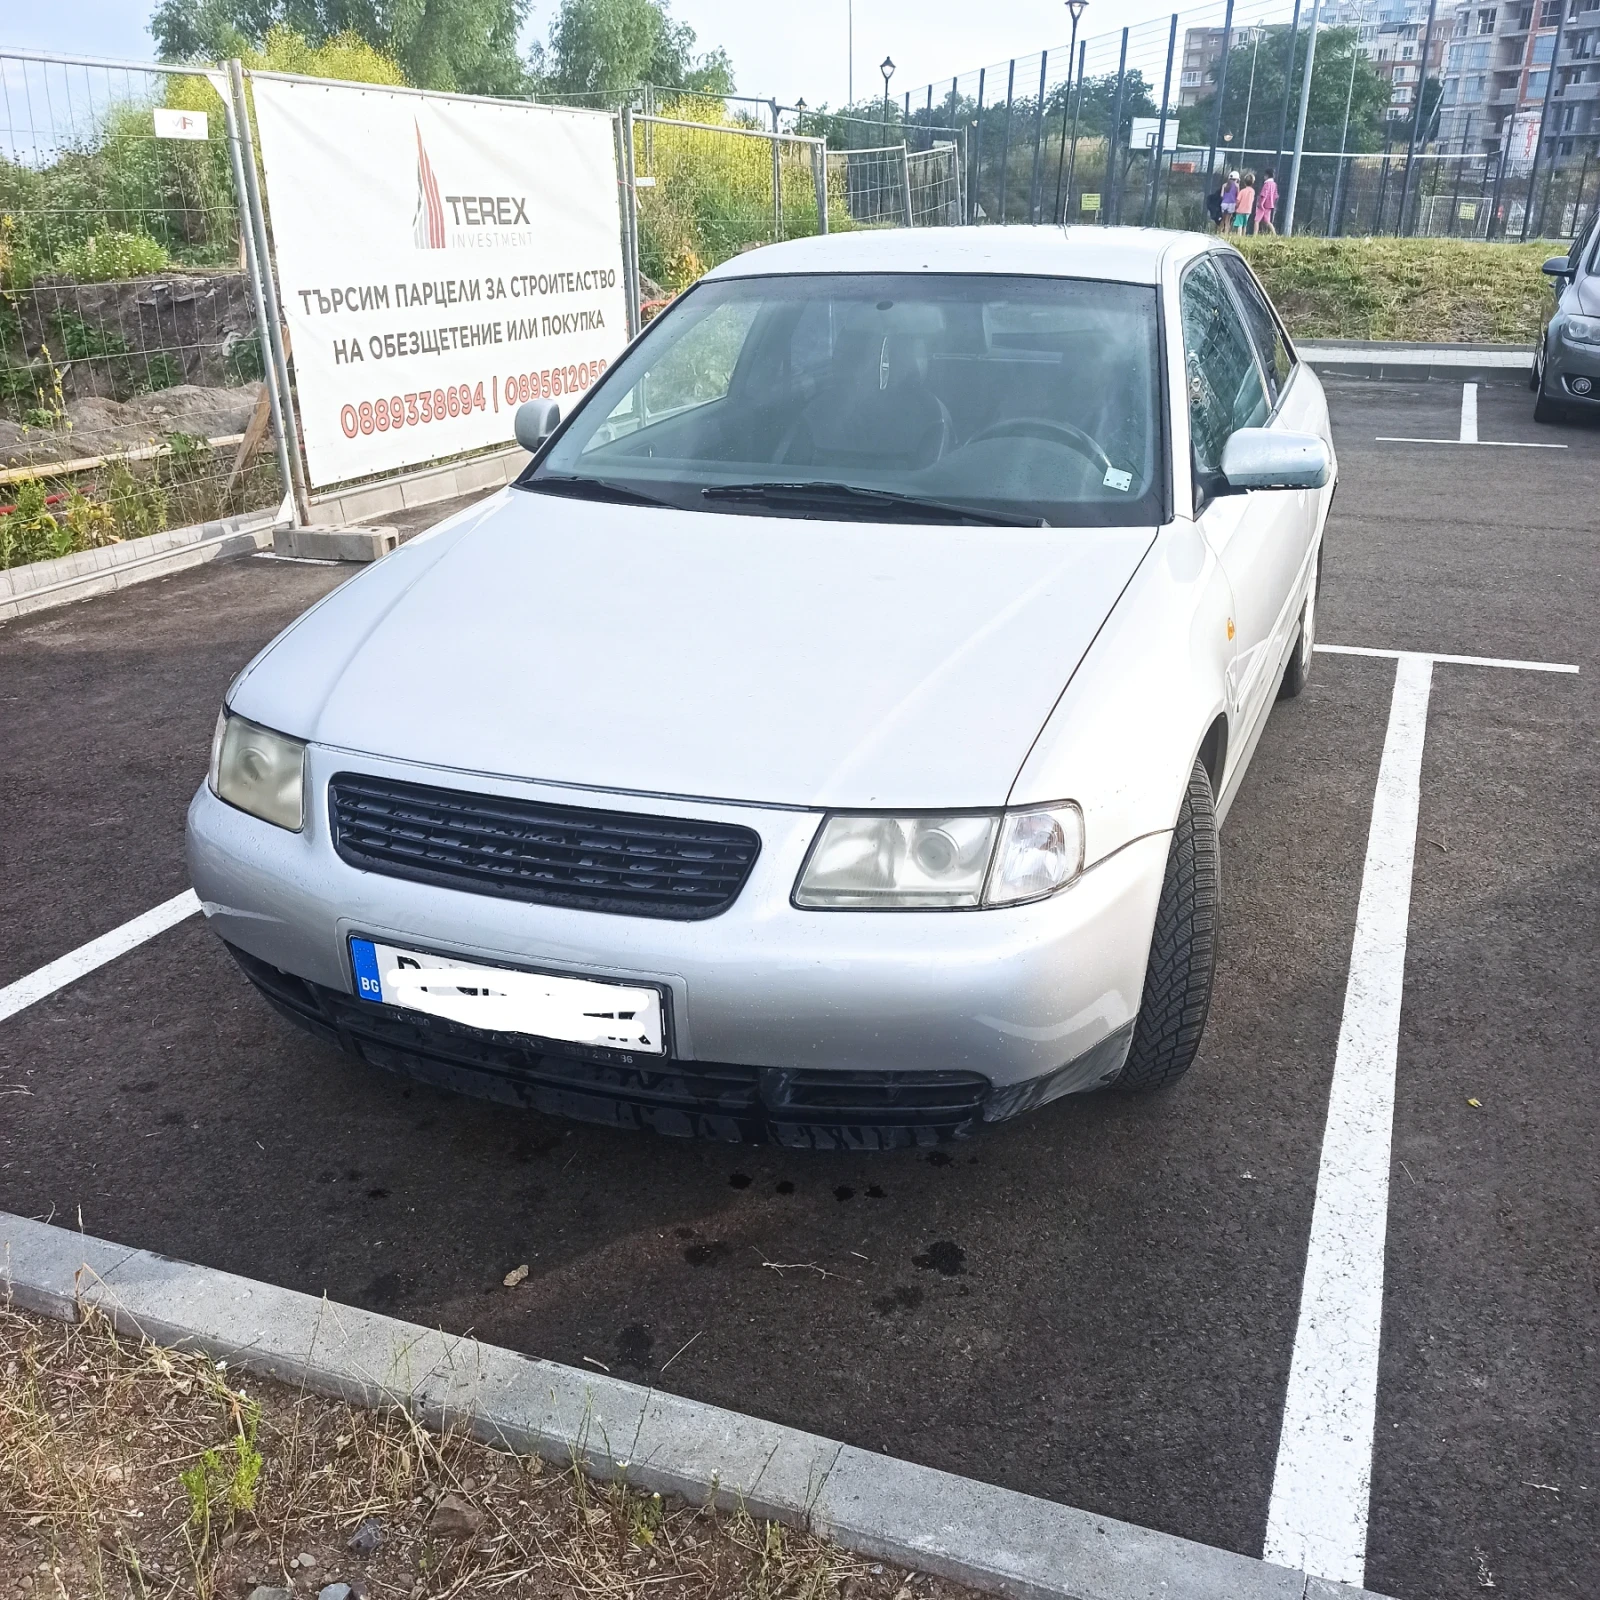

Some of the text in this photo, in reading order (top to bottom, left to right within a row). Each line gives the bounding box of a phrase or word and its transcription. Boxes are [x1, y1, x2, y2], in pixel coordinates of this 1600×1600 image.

[445, 196, 531, 225] TEREX
[452, 231, 532, 248] INVESTMENT
[298, 268, 616, 315] ТЪРСИМ ПАРЦЕЛИ ЗА СТРОИТЕЛСТВО
[333, 309, 606, 365] НА ОБЕЗЩЕТЕНИЕ ИЛИ ПОКУПКА
[340, 381, 487, 439] 0889338694
[360, 976, 380, 993] BG
